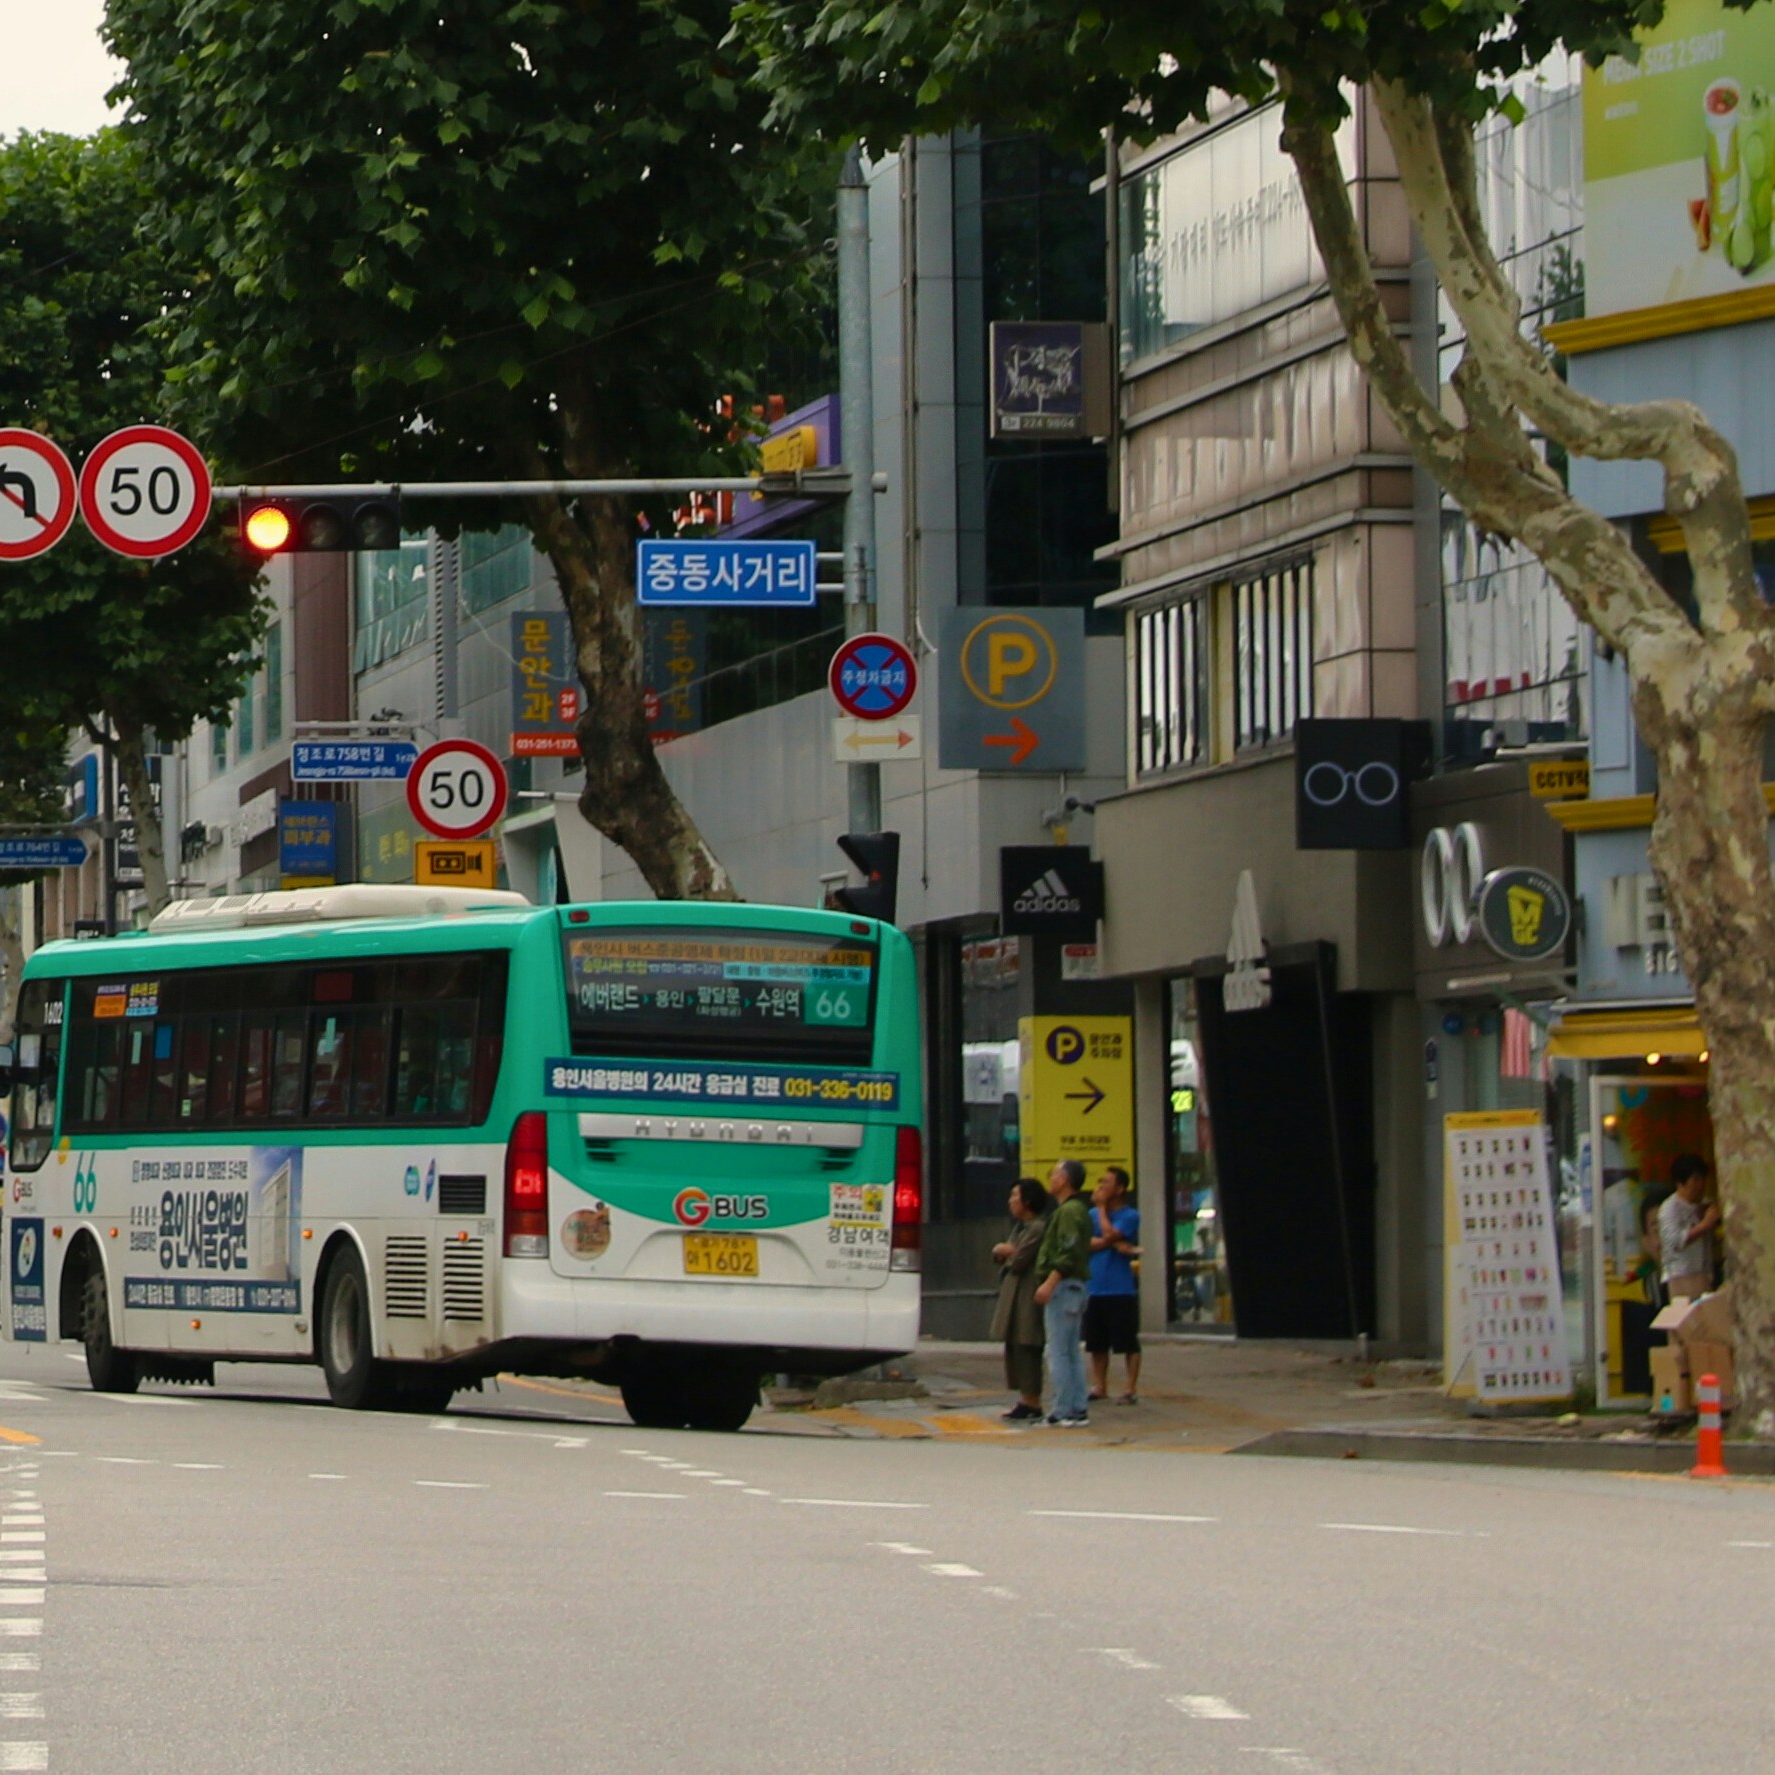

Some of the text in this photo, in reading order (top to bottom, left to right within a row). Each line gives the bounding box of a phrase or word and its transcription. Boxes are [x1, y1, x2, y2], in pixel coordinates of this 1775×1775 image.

[110, 466, 181, 516] 50
[646, 552, 806, 593] 중동사거리
[519, 620, 554, 722] 문안과
[841, 669, 905, 685] 주정차금지
[429, 770, 484, 809] 50
[1014, 898, 1080, 913] adidas
[581, 982, 850, 1019] 에버랜드 용인 팔달문 수원역 66
[552, 1067, 893, 1101] 용인서울병원의 24시간 응급실 진료 031-336-0119
[74, 1151, 96, 1213] 66
[160, 1190, 248, 1271] 용인서울병원
[704, 1252, 753, 1271] 1602
